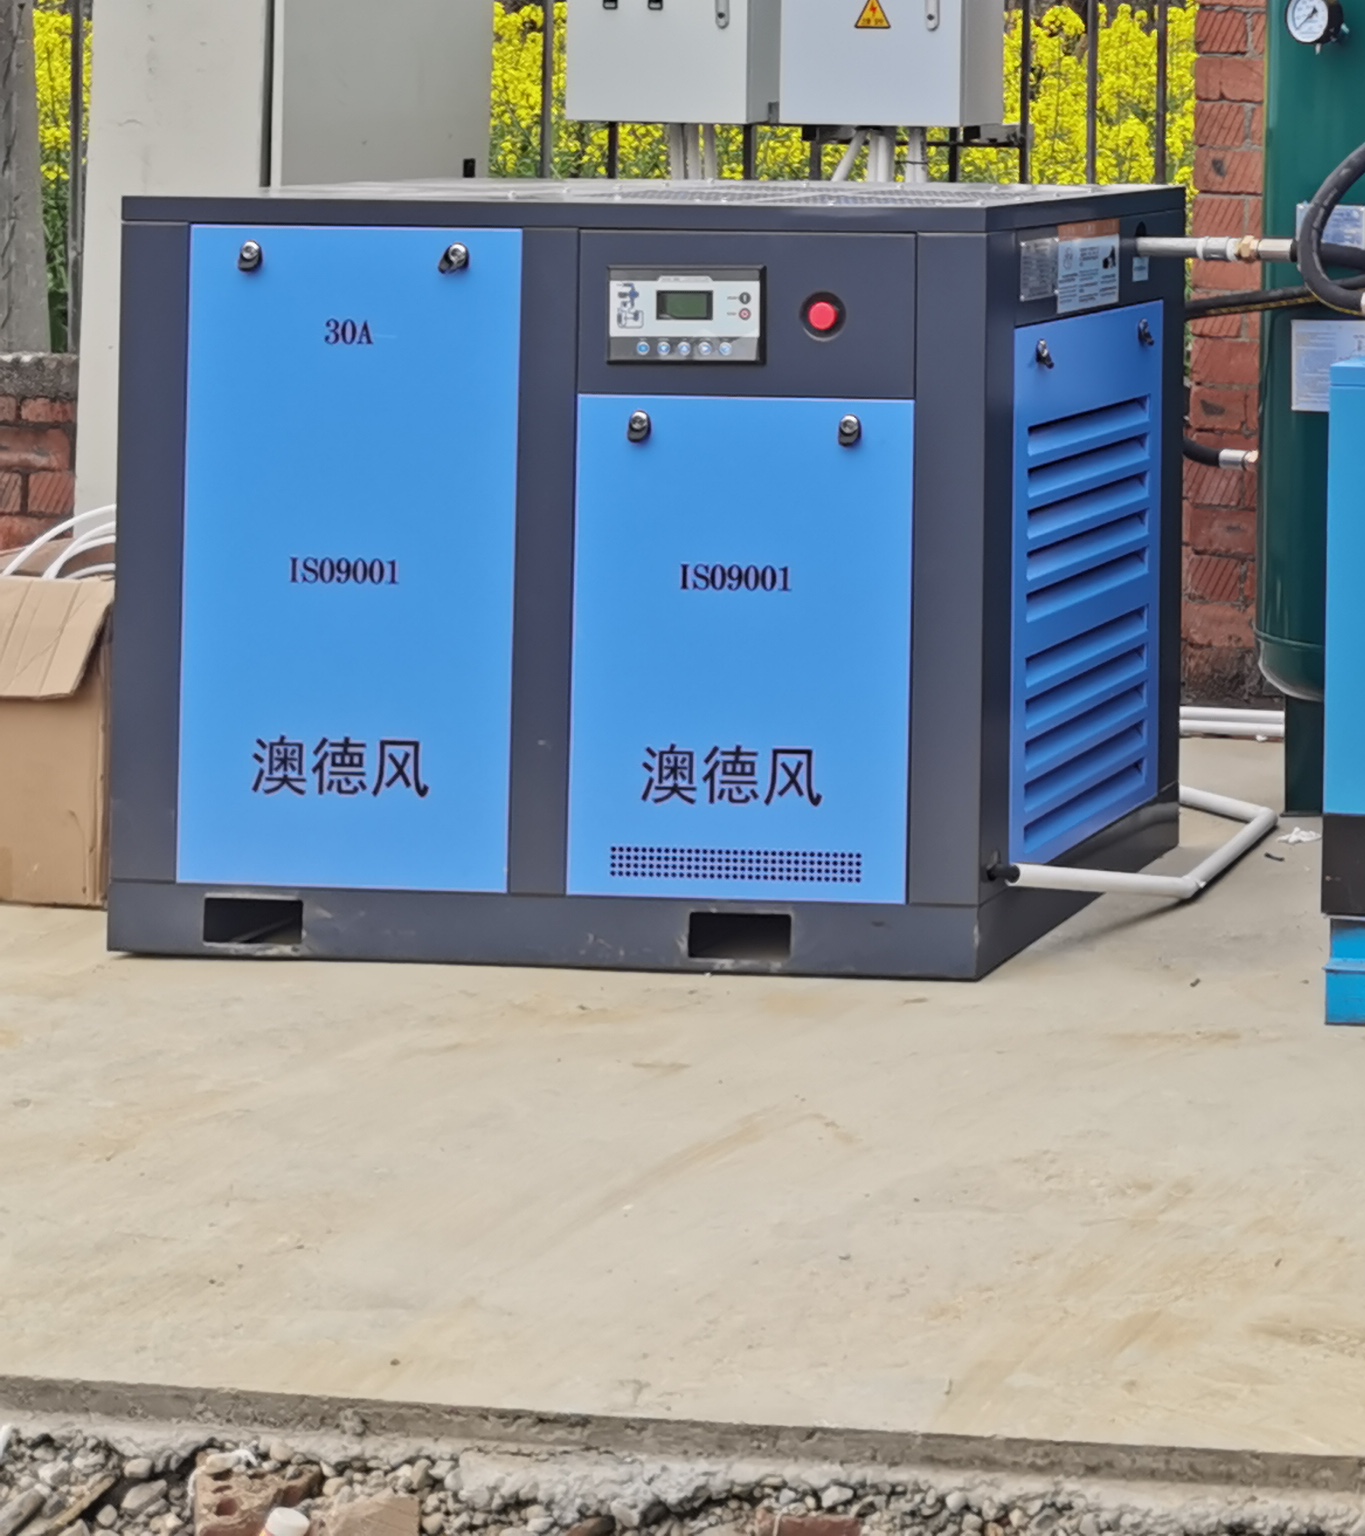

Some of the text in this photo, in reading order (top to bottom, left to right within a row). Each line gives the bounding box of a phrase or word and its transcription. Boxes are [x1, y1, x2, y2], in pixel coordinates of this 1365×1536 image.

[324, 319, 374, 346] 30A
[251, 733, 430, 800] 澳德风
[641, 743, 823, 808] 澳德风
